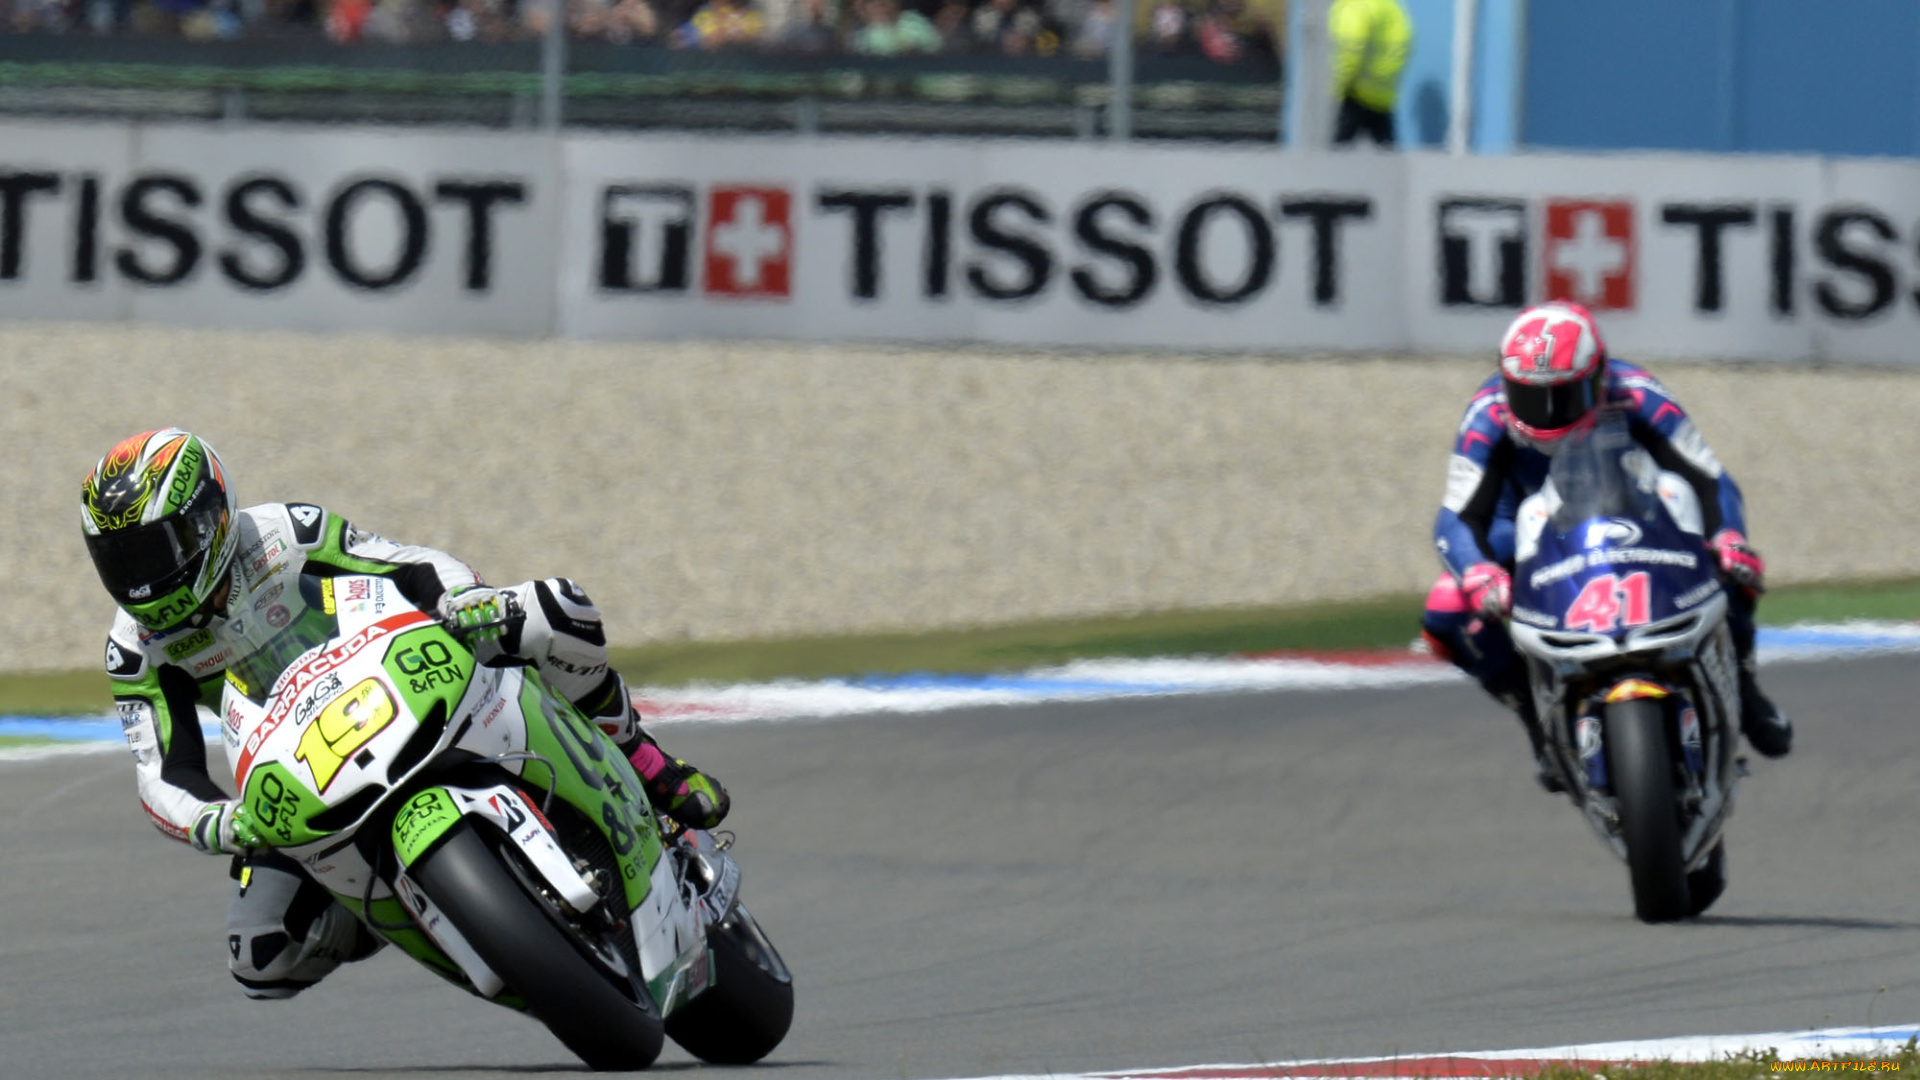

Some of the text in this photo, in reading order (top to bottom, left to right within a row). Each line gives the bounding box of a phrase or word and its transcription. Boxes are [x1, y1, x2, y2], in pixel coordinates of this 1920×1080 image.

[0, 173, 524, 289] TISSOT
[817, 188, 1372, 306] TISSOT
[1661, 203, 1920, 319] TIS
[167, 446, 202, 507] GO&FUN
[251, 544, 281, 573] Castrol
[1564, 571, 1652, 633] 41
[276, 648, 320, 691] HONDA
[395, 640, 453, 676] GO
[409, 664, 464, 694] &FUN
[246, 624, 389, 753] BARRACUDA
[483, 697, 507, 728] HONDA
[294, 676, 400, 796] 19
[255, 772, 284, 828] GO
[276, 788, 300, 842] &FUN
